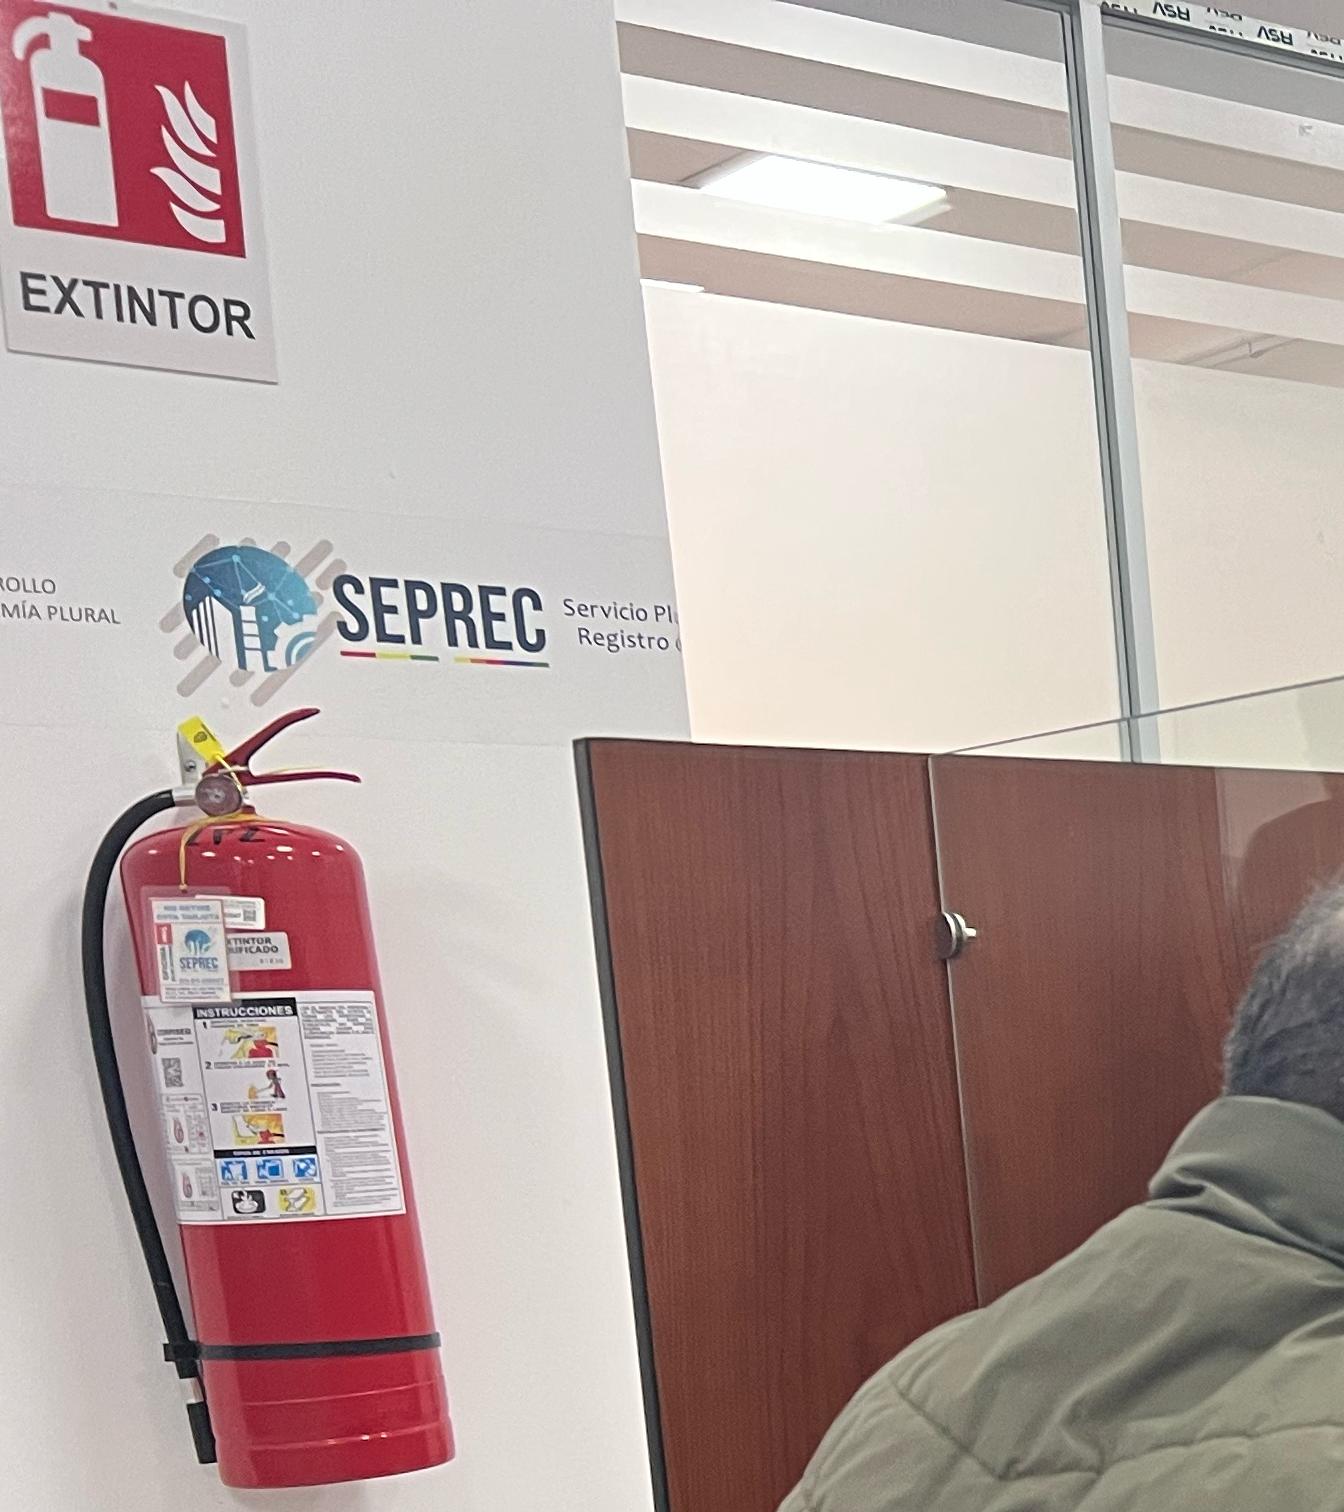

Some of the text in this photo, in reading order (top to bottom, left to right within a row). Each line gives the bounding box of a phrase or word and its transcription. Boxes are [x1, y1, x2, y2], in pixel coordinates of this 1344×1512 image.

[1152, 2, 1191, 22] RSV
[1257, 25, 1293, 46] RSV
[19, 270, 256, 340] EXTINTOR
[47, 605, 121, 625] PLURAL
[332, 574, 547, 653] SEPREC
[563, 598, 648, 622] Servicio
[577, 627, 670, 653] Registro
[196, 1005, 294, 1018] INSTRUCCIONES
